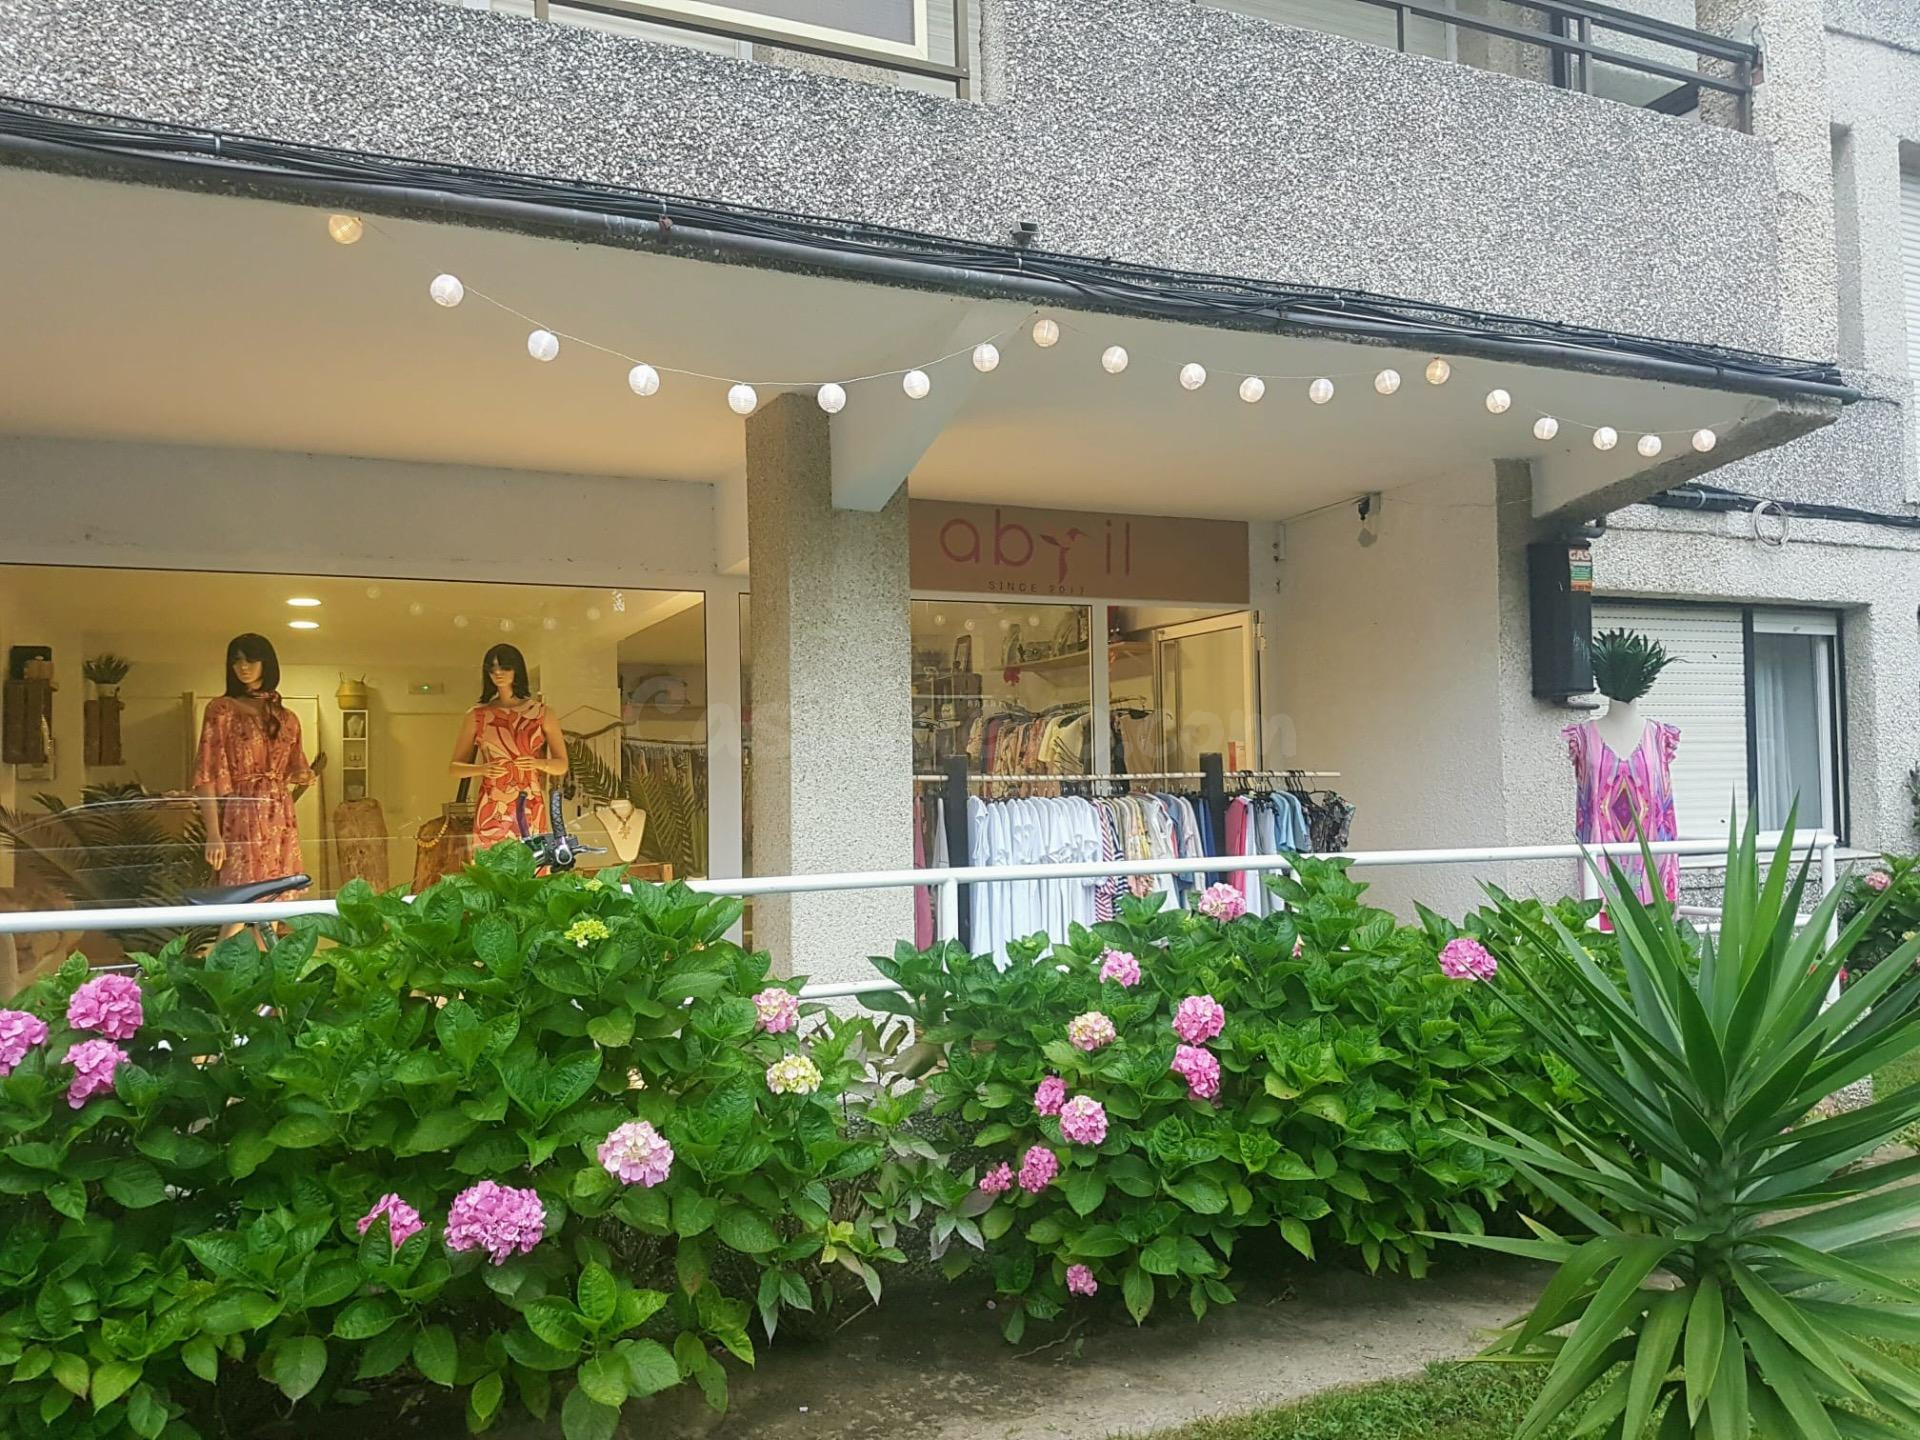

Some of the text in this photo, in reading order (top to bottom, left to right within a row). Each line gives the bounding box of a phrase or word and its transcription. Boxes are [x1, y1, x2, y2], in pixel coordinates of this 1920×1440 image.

[939, 508, 1131, 584] abril
[1569, 550, 1591, 560] GAS
[988, 581, 1037, 593] SINCE
